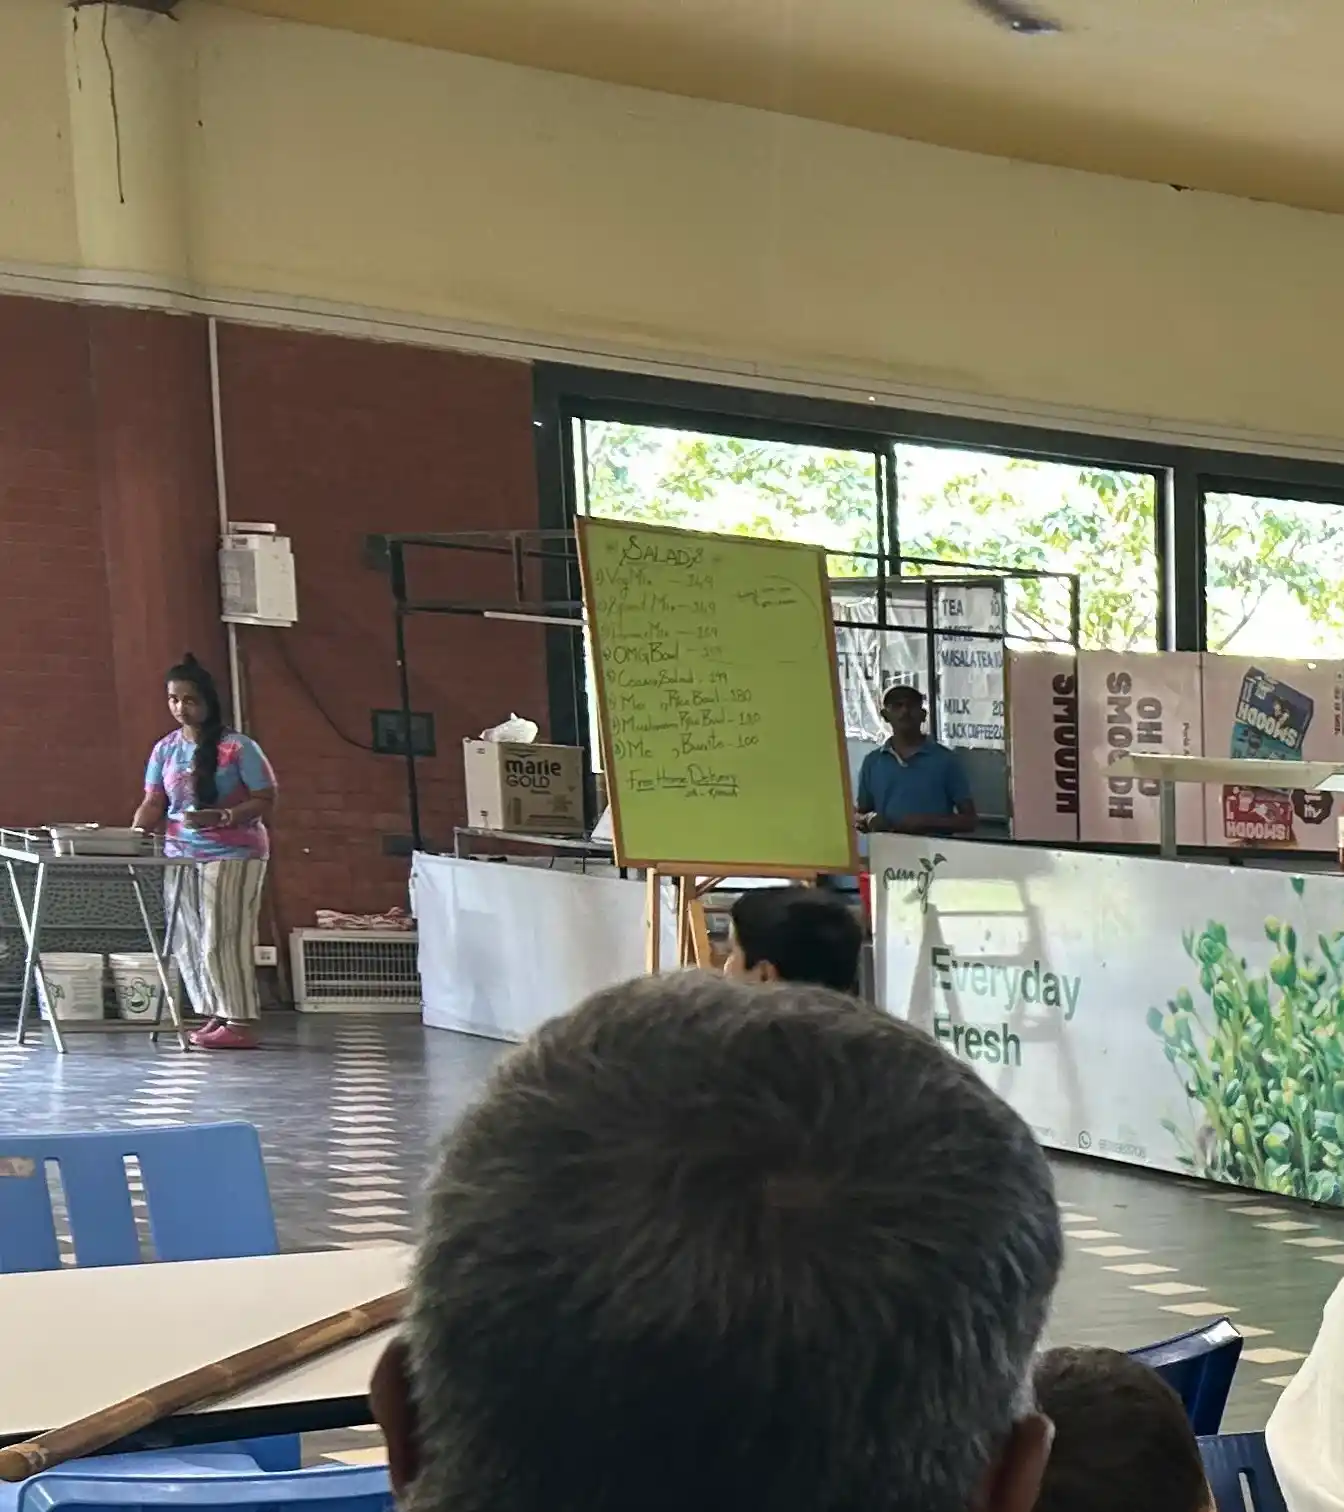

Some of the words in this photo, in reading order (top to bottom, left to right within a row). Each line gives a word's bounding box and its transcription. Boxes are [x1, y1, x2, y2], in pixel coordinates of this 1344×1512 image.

[941, 599, 964, 616] TEA
[944, 698, 971, 715] MILK
[1136, 696, 1163, 745] OH
[506, 759, 562, 777] marie
[506, 775, 550, 788] GOLD
[931, 946, 1082, 1021] Everyday
[933, 1016, 1022, 1067] Fresh
